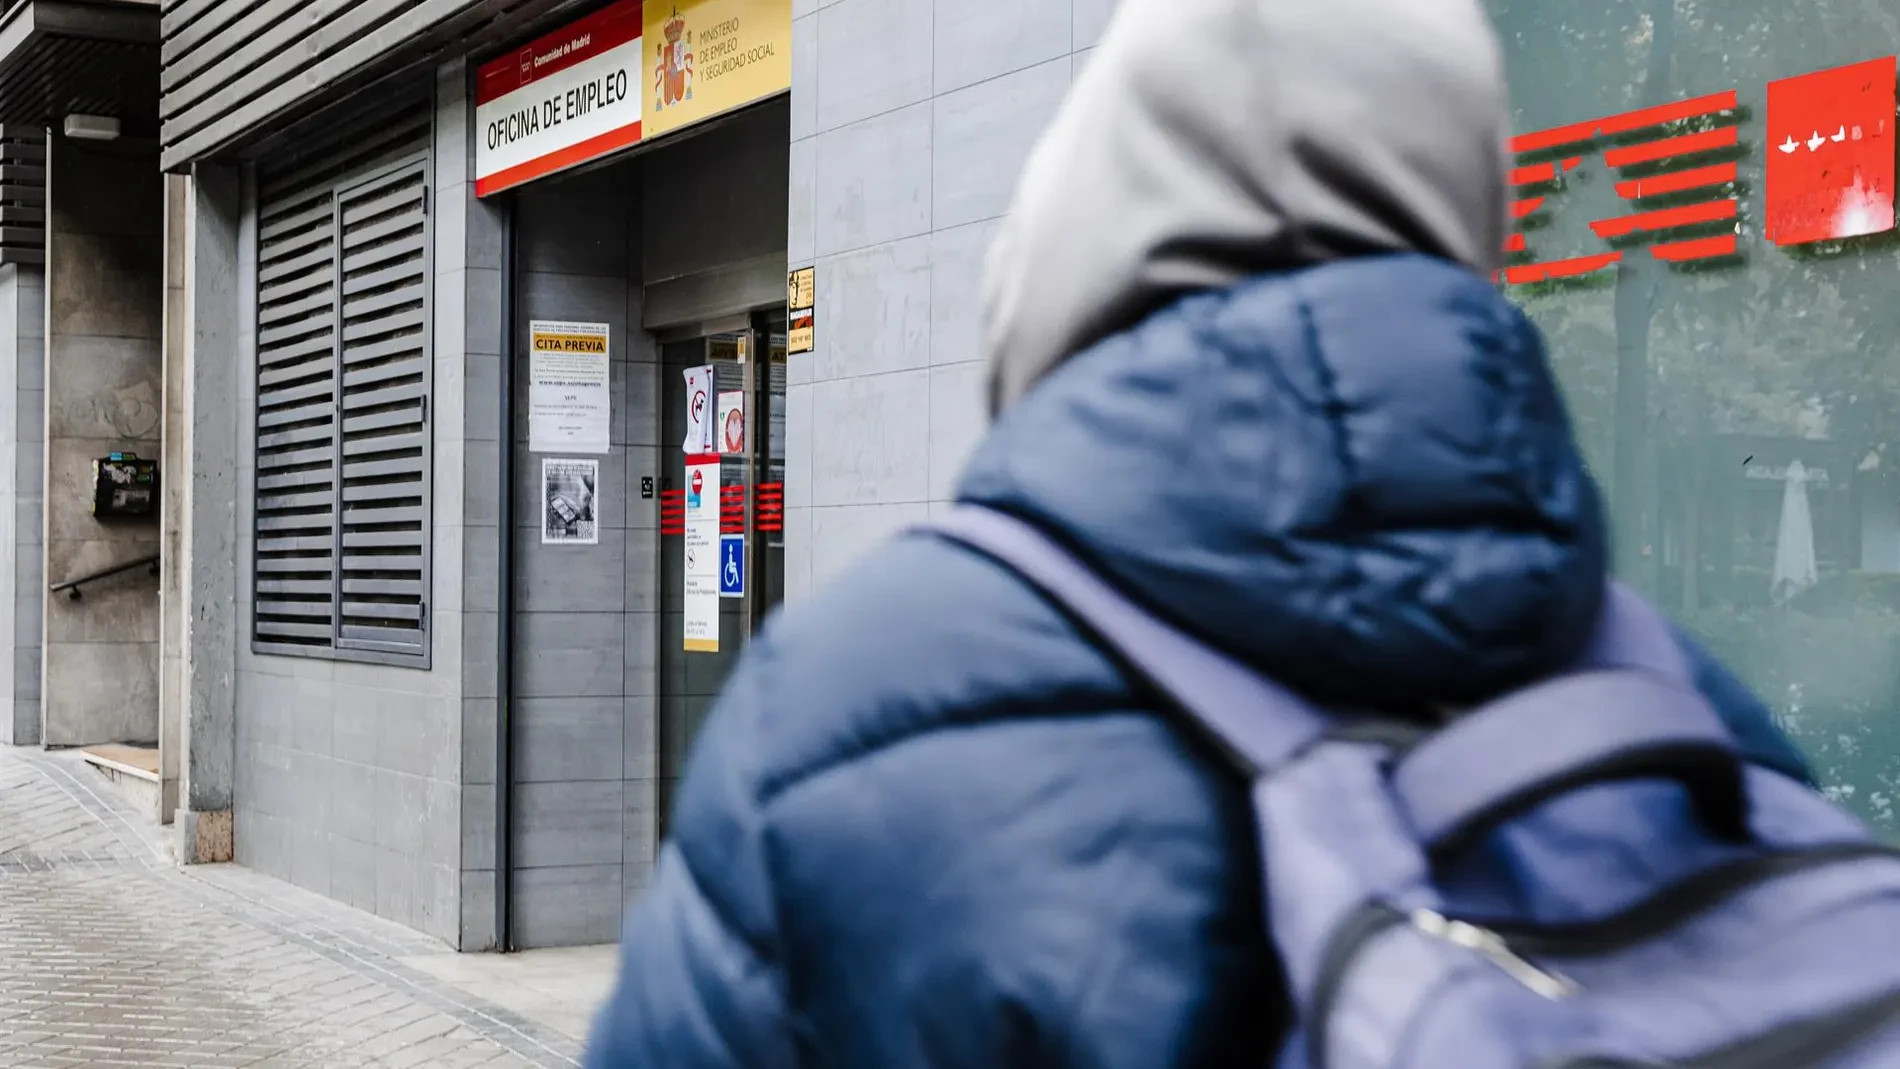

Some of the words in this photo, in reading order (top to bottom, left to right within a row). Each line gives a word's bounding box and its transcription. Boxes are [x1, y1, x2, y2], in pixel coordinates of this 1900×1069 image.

[700, 17, 740, 45] MINISTERIO
[534, 45, 563, 68] Comunidad
[563, 43, 571, 55] de
[571, 32, 591, 52] Madrid
[699, 69, 705, 83] Y
[705, 53, 746, 82] SEGURIDAD
[747, 41, 775, 65] SOCIAL
[700, 47, 710, 65] DE
[710, 37, 738, 61] EMPLEO
[487, 105, 540, 151] OFICINA
[543, 95, 562, 130] DE
[566, 68, 628, 121] EMPLEO
[536, 339, 562, 350] CITA
[565, 340, 604, 352] PREVIA
